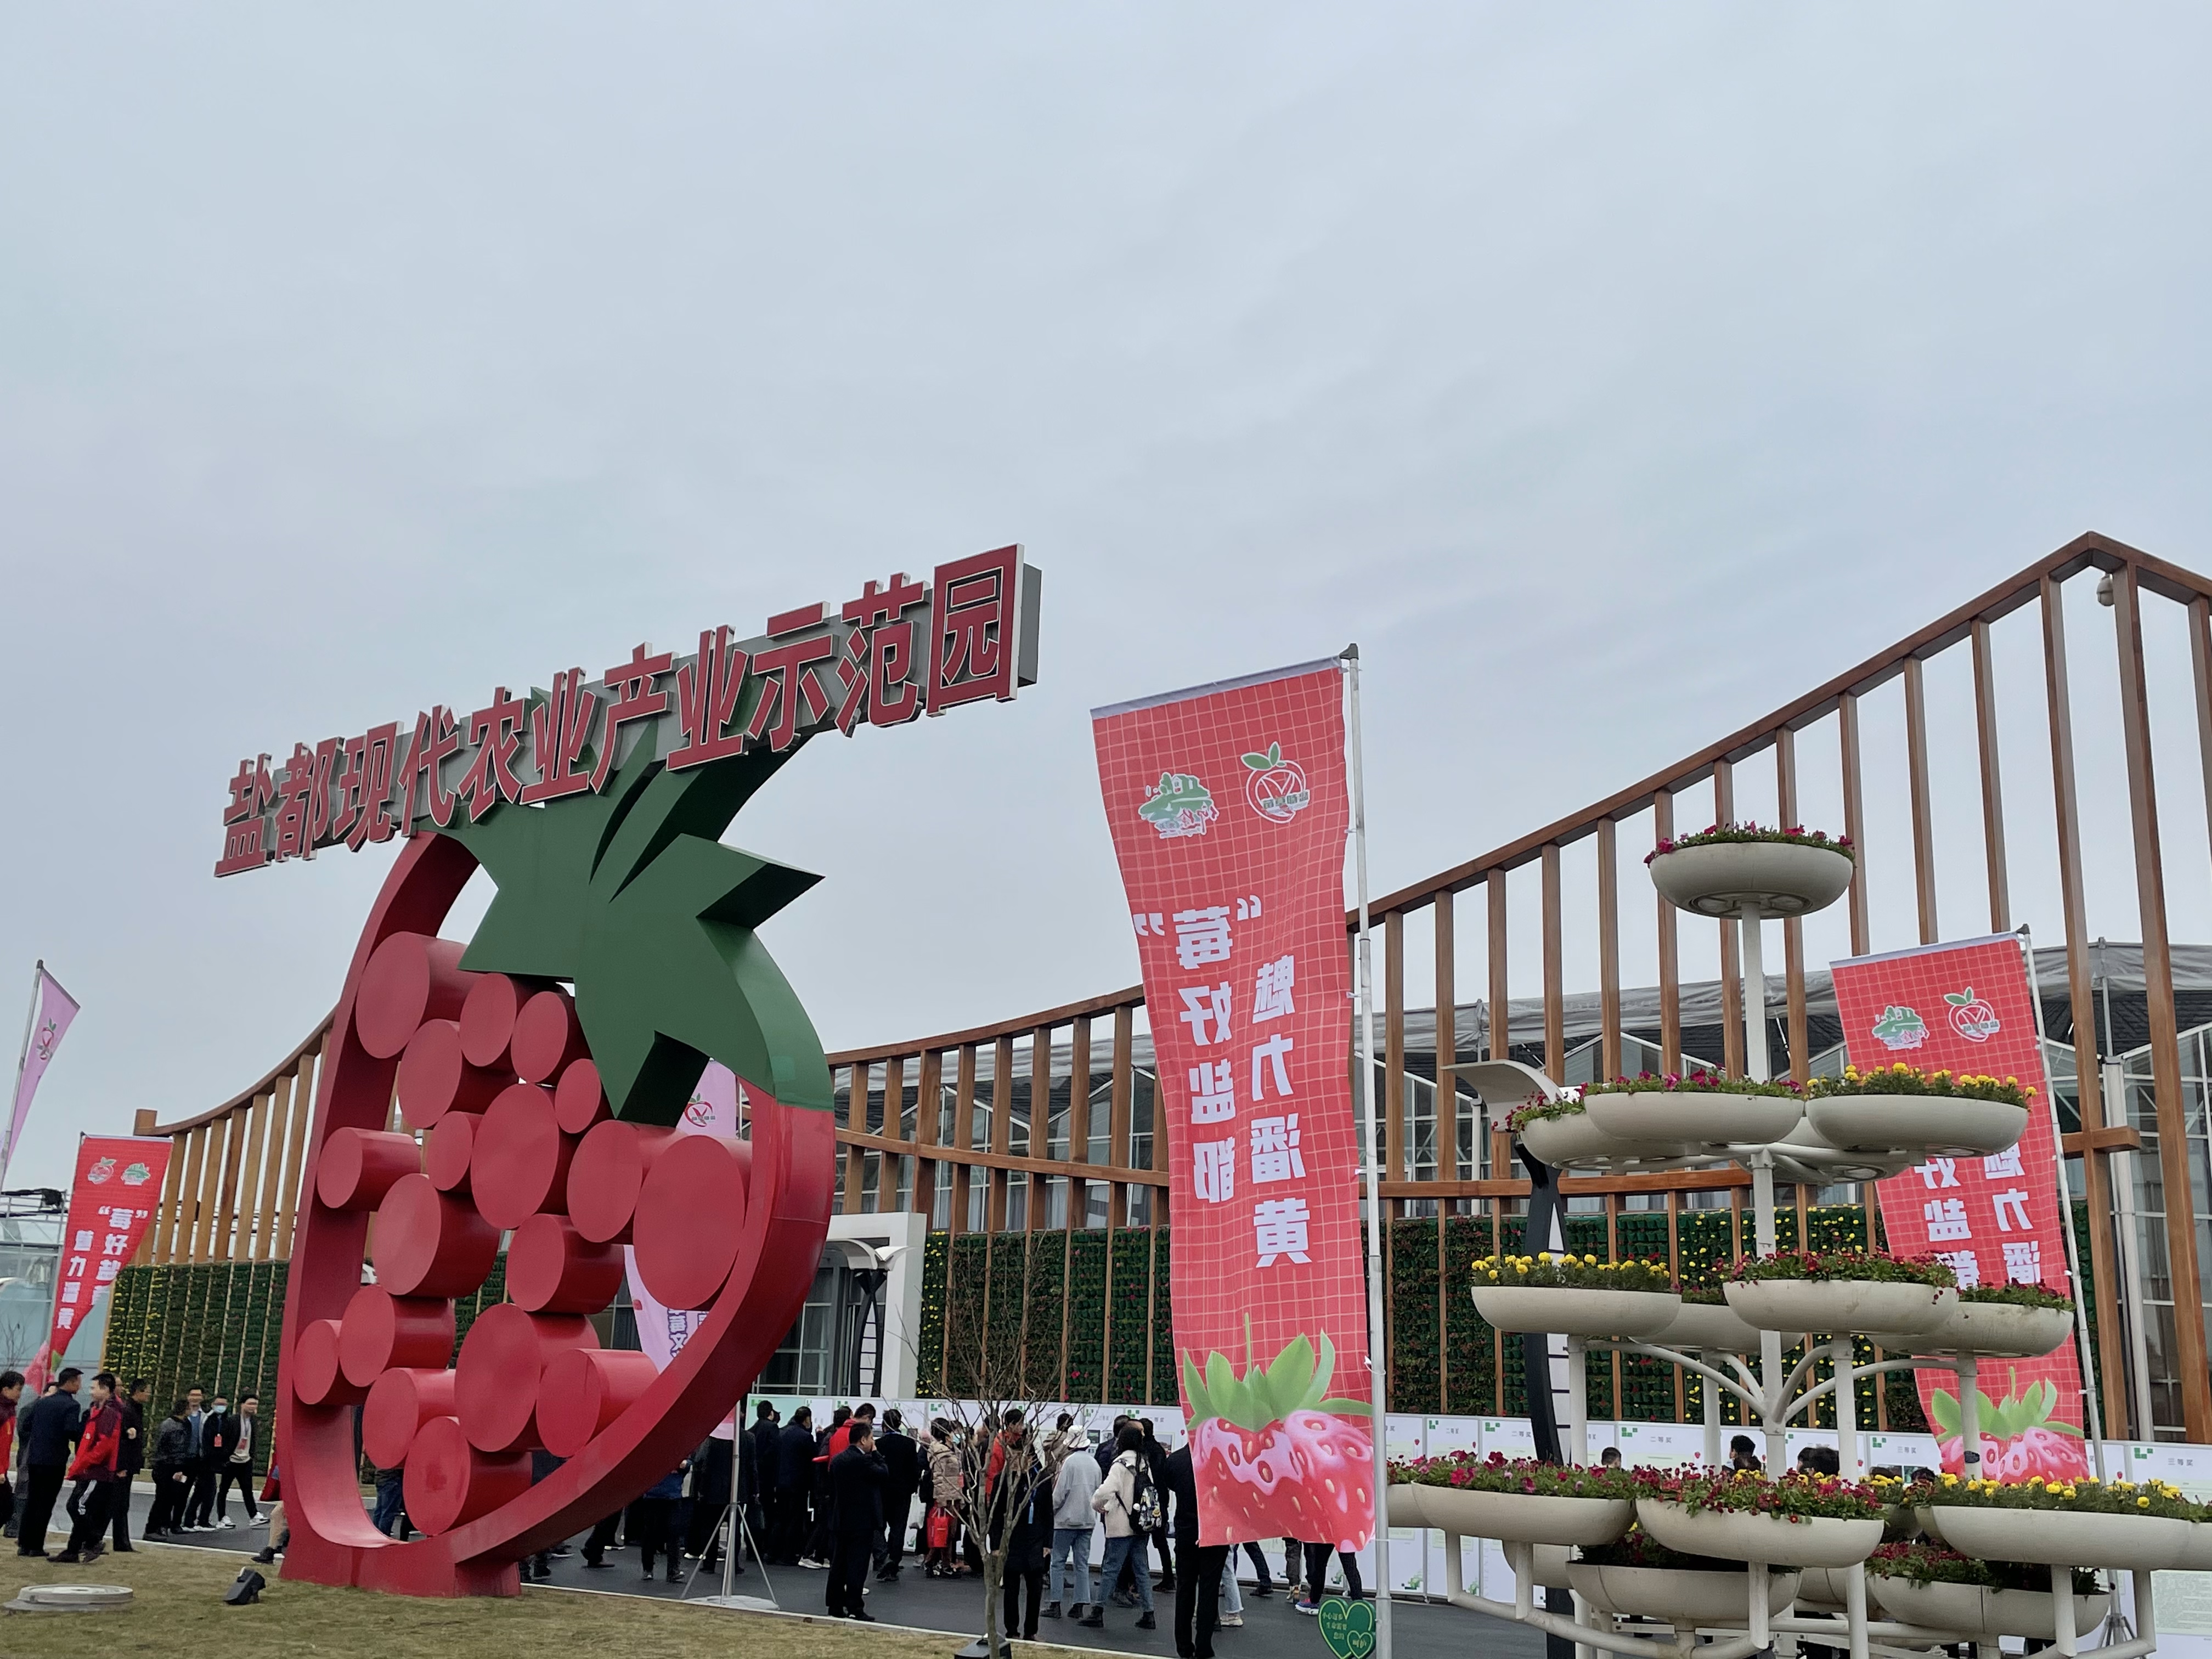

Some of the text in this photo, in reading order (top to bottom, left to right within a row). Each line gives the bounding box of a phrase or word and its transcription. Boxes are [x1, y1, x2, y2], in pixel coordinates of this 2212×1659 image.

[215, 543, 1025, 877] 盐都现代农业产业示范园
